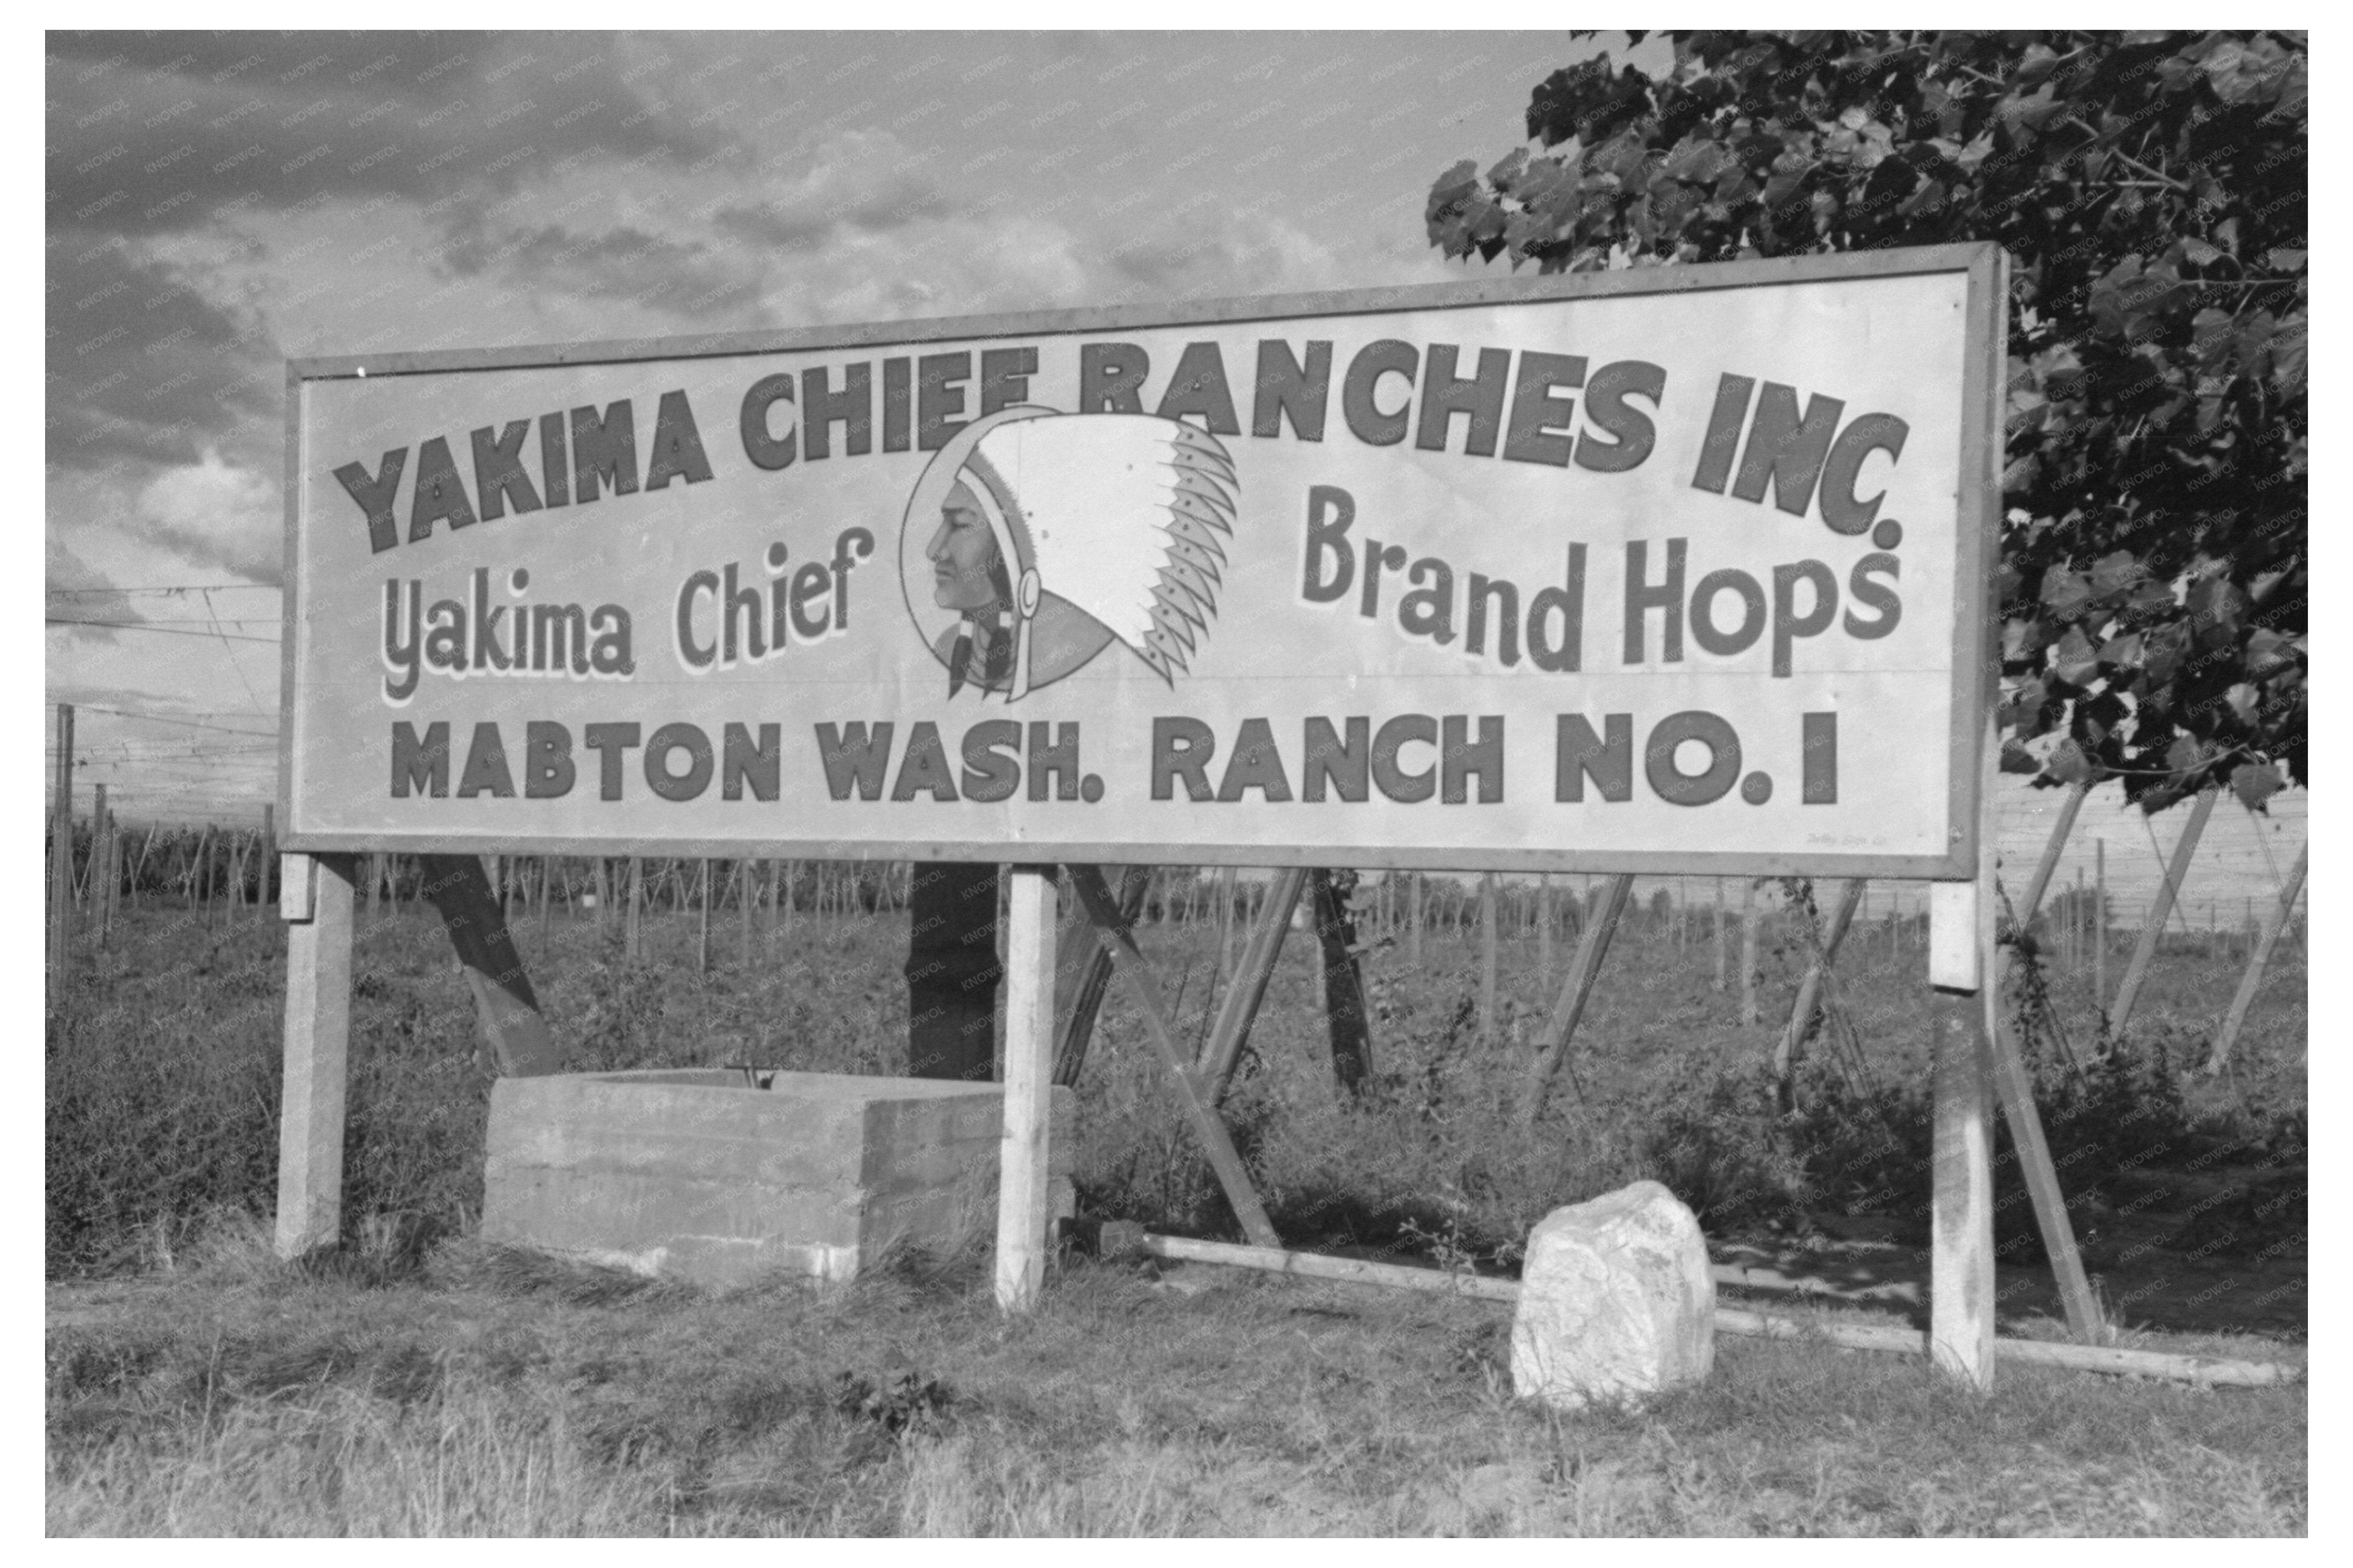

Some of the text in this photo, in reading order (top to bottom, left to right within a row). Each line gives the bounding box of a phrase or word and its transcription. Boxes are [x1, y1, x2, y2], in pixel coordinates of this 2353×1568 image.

[331, 339, 1910, 555] YAKIMA CHIEF RANCHES INC.
[383, 485, 1902, 705] Yakima Chief Brand Hops
[390, 721, 781, 803] MABTON
[814, 720, 1104, 804] WASH.
[1151, 714, 1505, 804] RANCH
[1555, 711, 1773, 807] NO.
